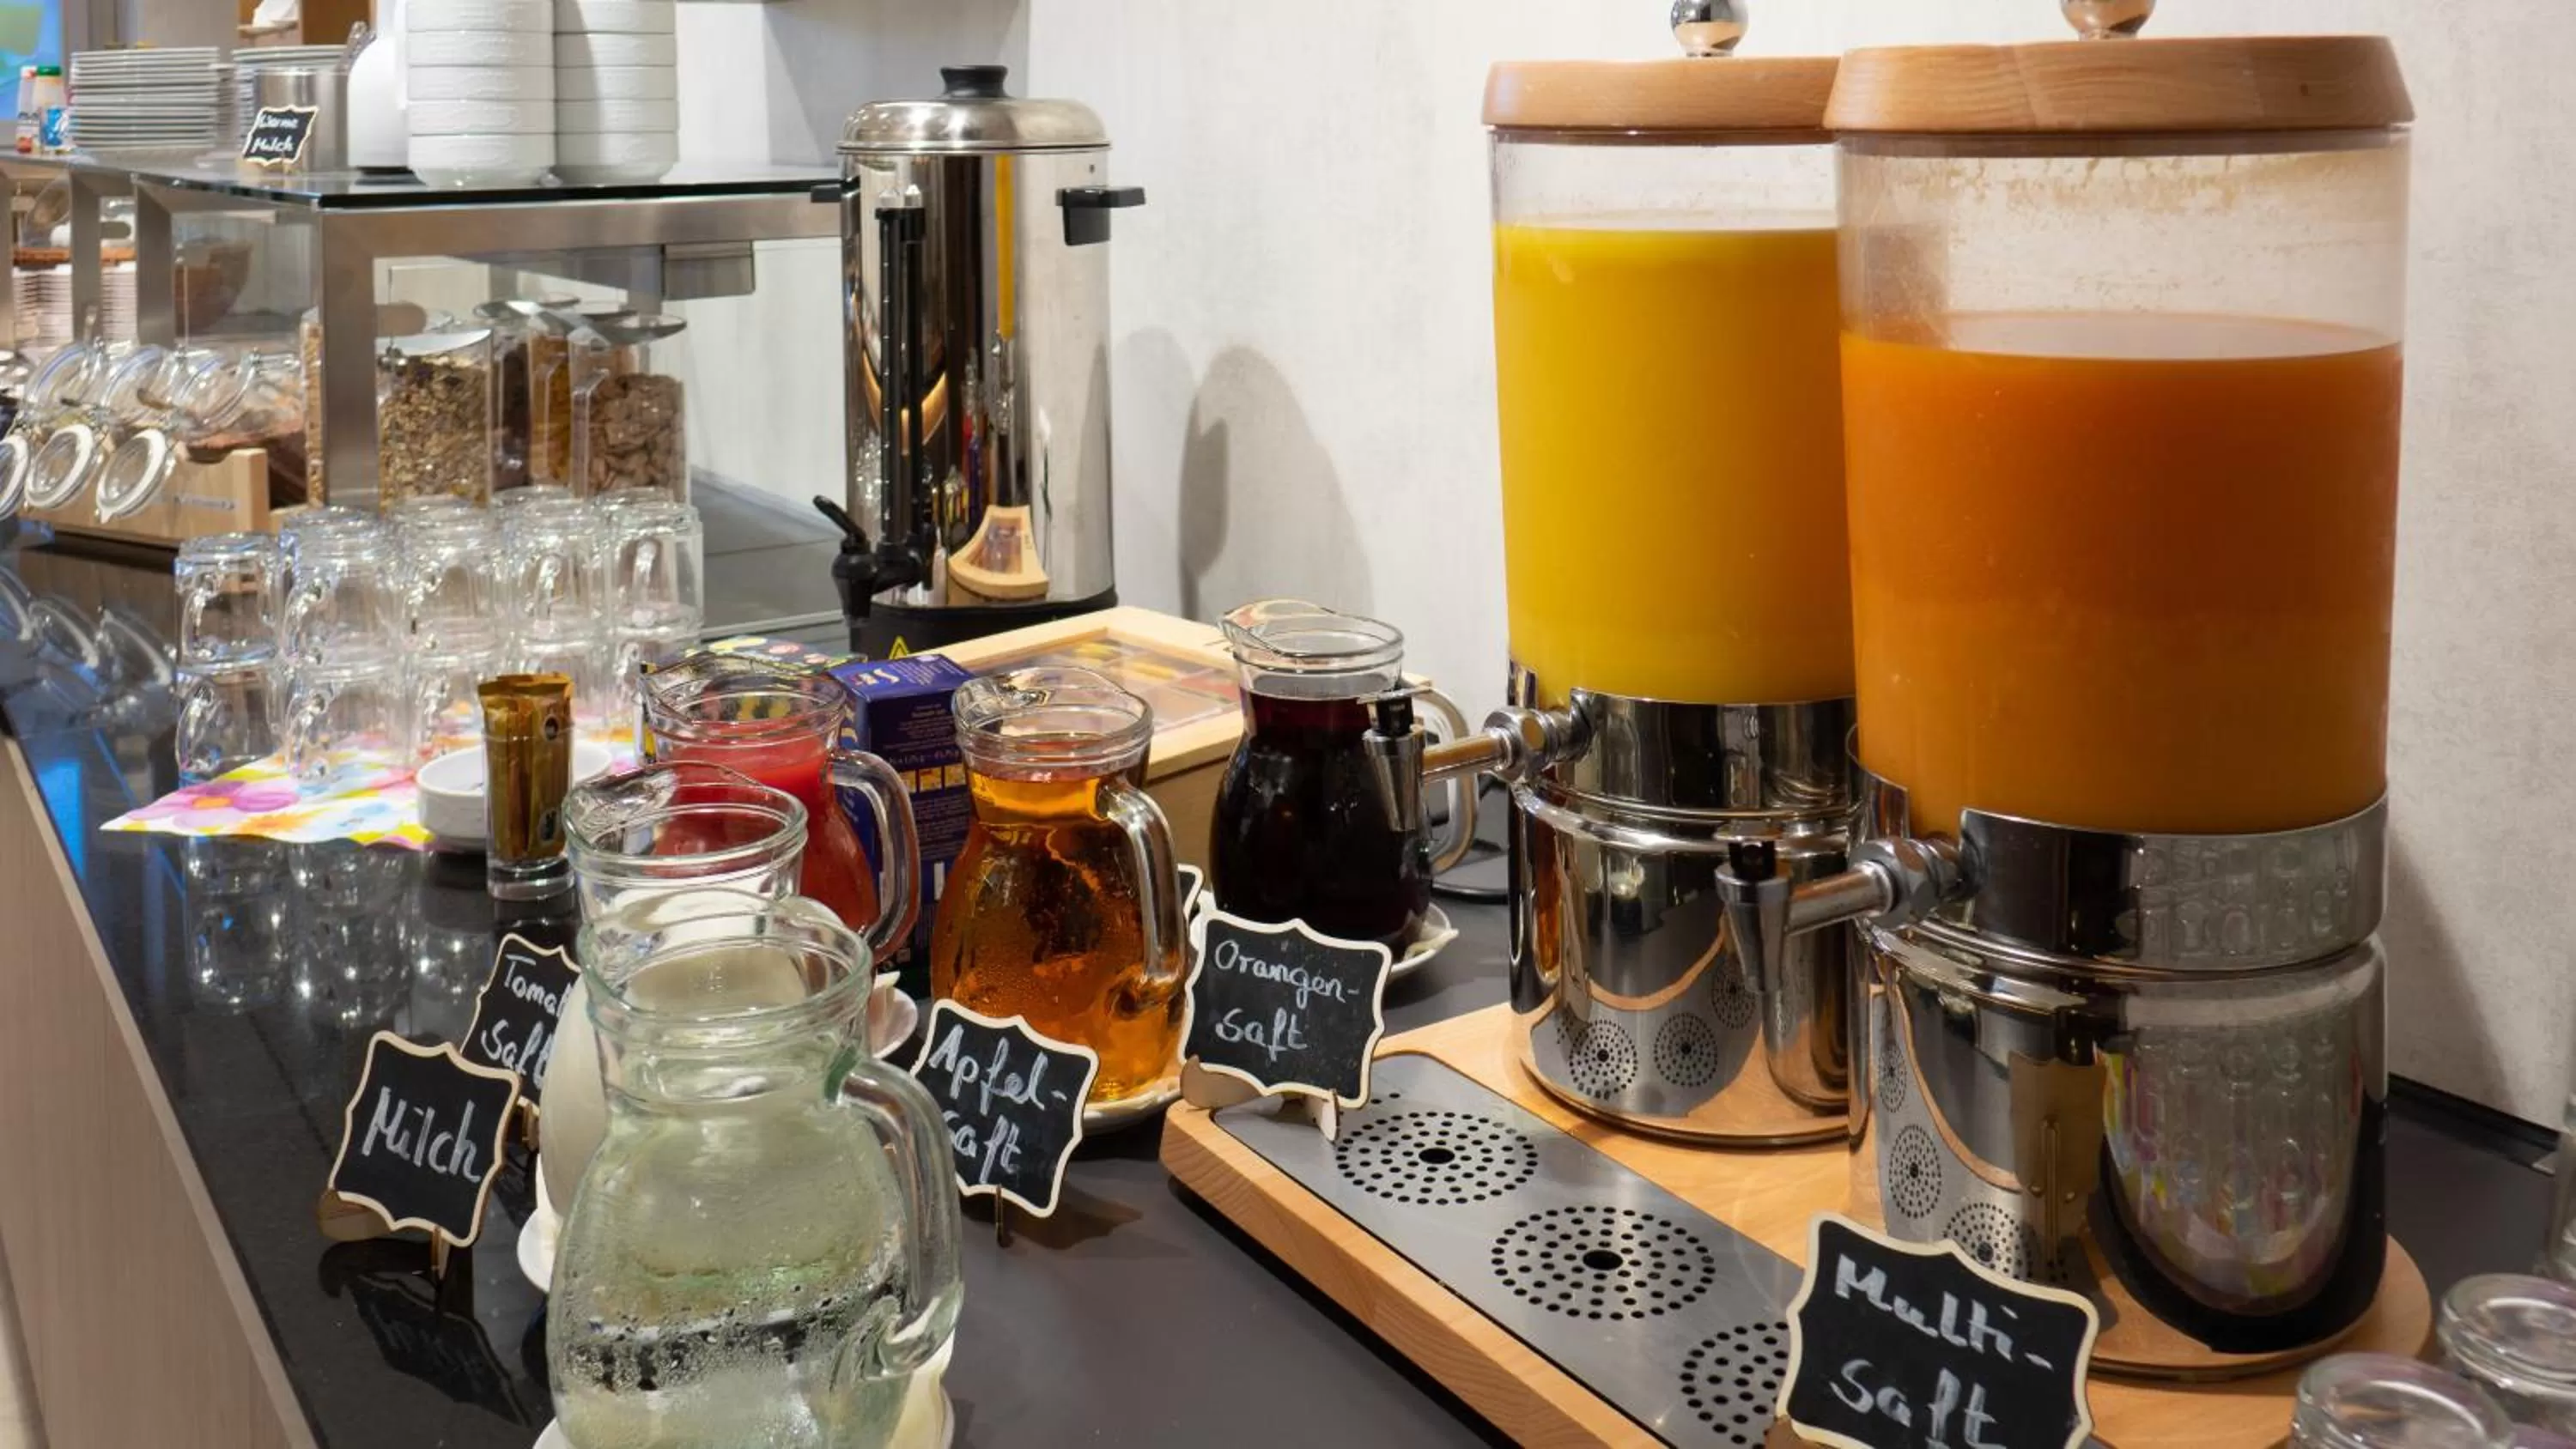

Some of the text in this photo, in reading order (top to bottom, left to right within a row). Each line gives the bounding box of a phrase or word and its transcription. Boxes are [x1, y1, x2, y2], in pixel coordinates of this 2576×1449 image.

[250, 135, 294, 154] Milch
[1214, 939, 1360, 1010] Orangen-
[927, 1023, 1068, 1116] Apfel-
[1215, 1007, 1309, 1063] Saft
[361, 1086, 482, 1183] Milch
[1834, 1252, 2054, 1371] Multi-
[1828, 1359, 2008, 1449] Saft
